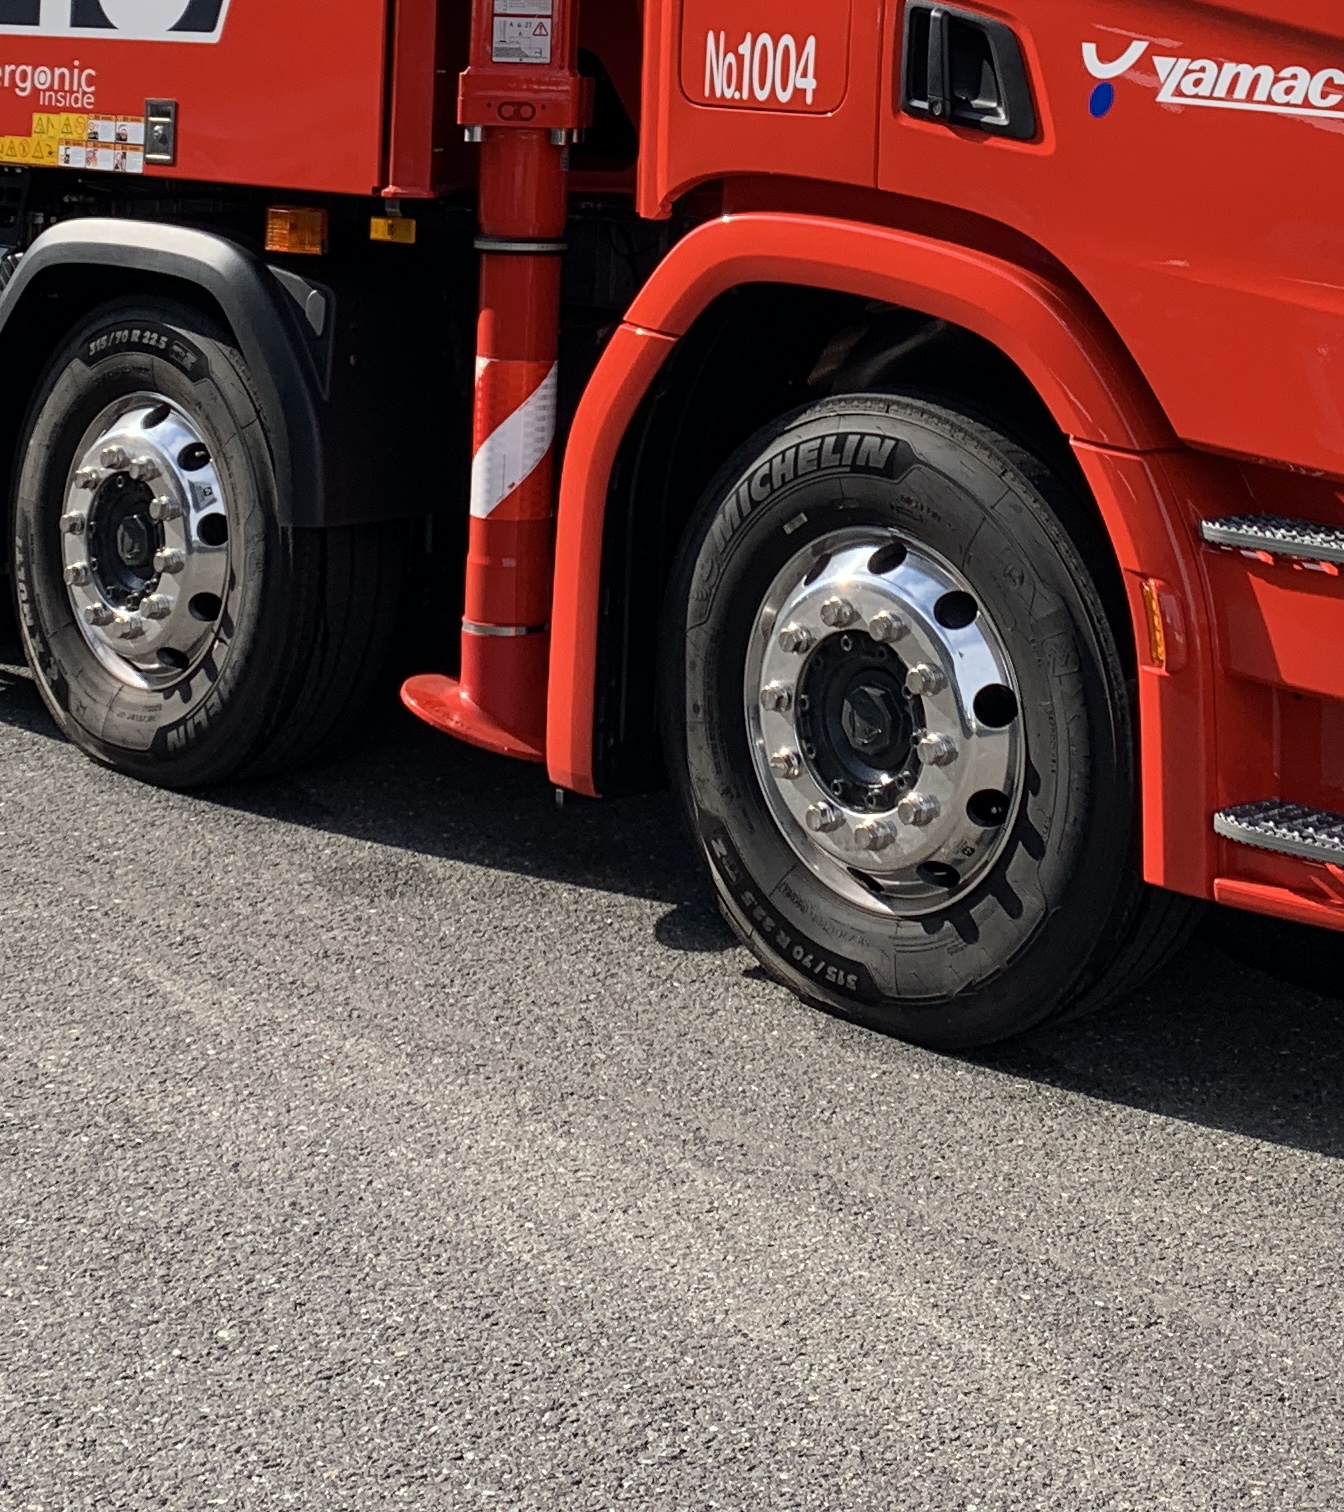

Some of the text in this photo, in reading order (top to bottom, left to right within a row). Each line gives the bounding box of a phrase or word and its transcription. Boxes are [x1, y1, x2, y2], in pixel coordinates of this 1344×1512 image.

[39, 88, 96, 109] inside
[704, 29, 817, 105] No.1004
[712, 434, 896, 554] MICHELIN
